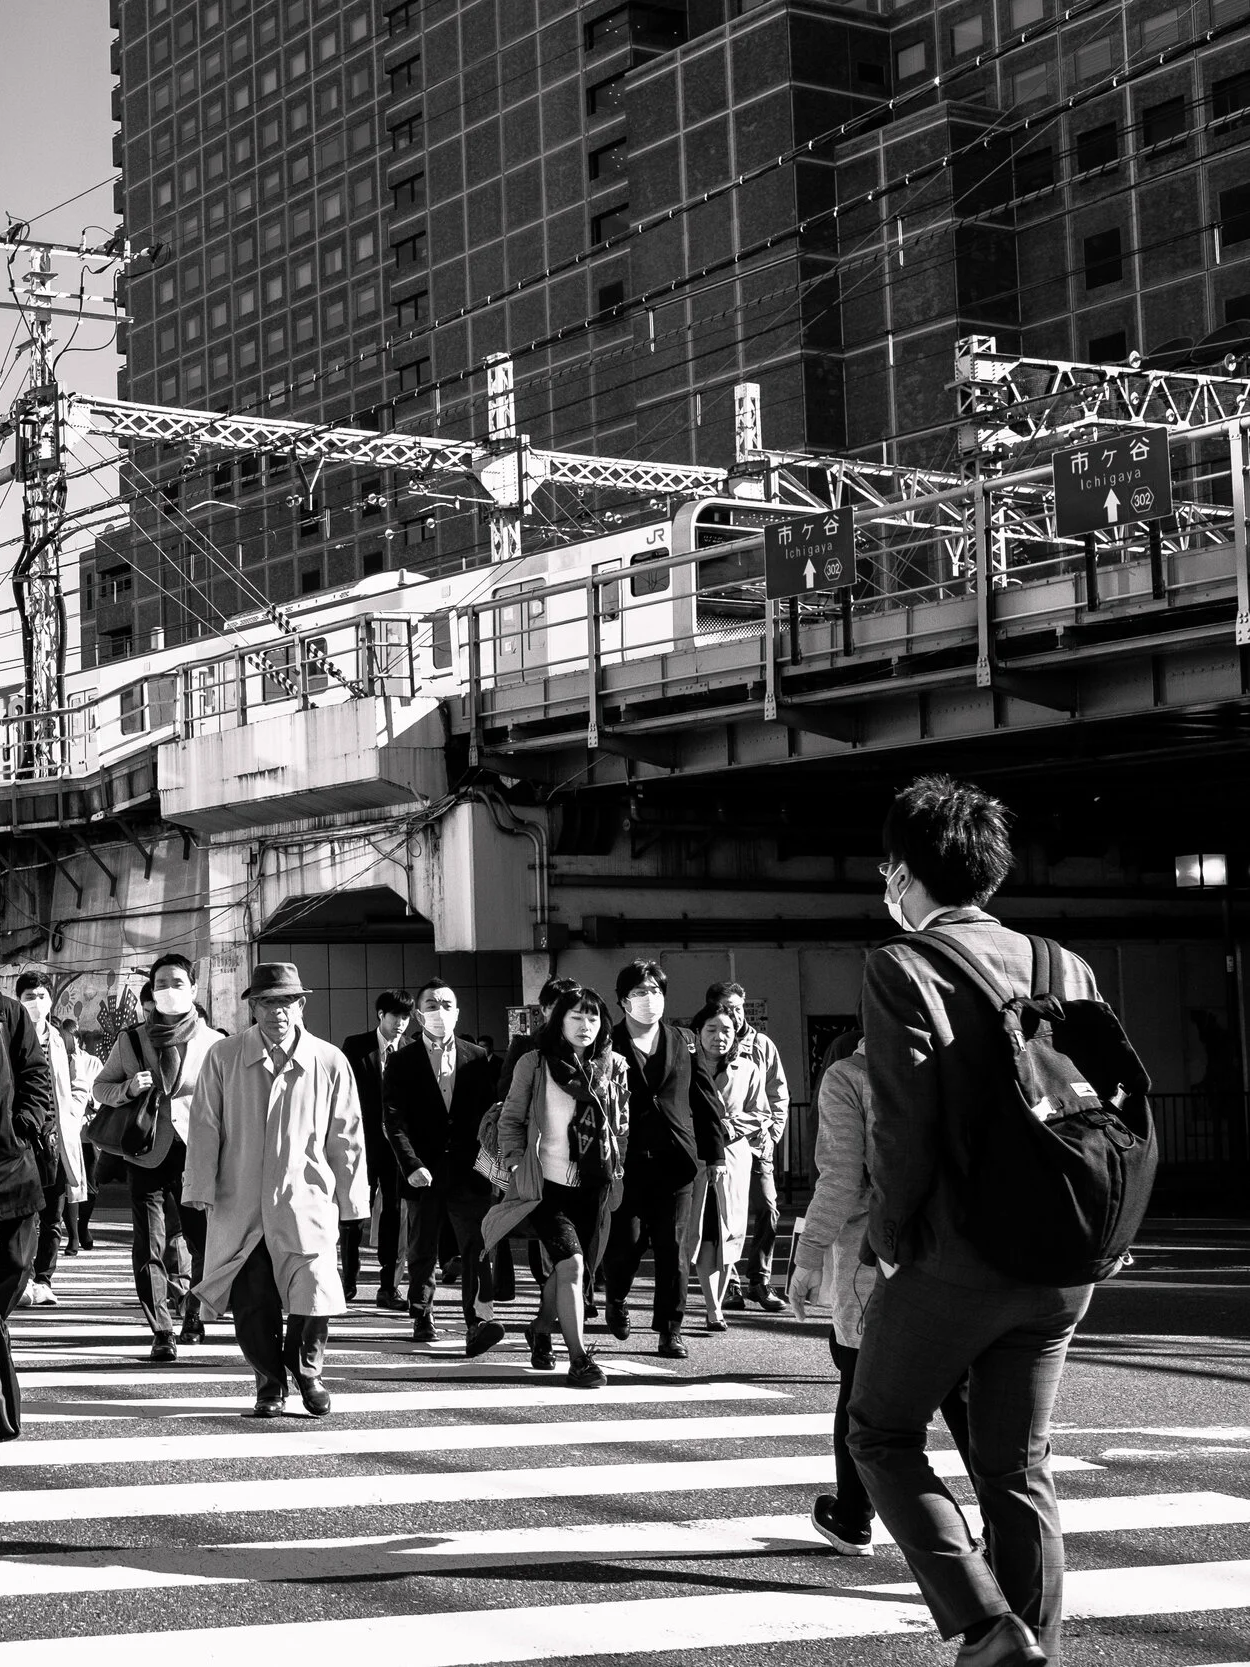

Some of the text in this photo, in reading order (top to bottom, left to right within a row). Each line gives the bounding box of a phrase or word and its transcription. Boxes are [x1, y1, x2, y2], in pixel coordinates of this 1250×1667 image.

[1080, 468, 1142, 491] Ichigaya
[1134, 492, 1151, 508] 302
[646, 527, 665, 545] JR
[785, 541, 833, 560] Ichigaya
[826, 563, 841, 577] 302
